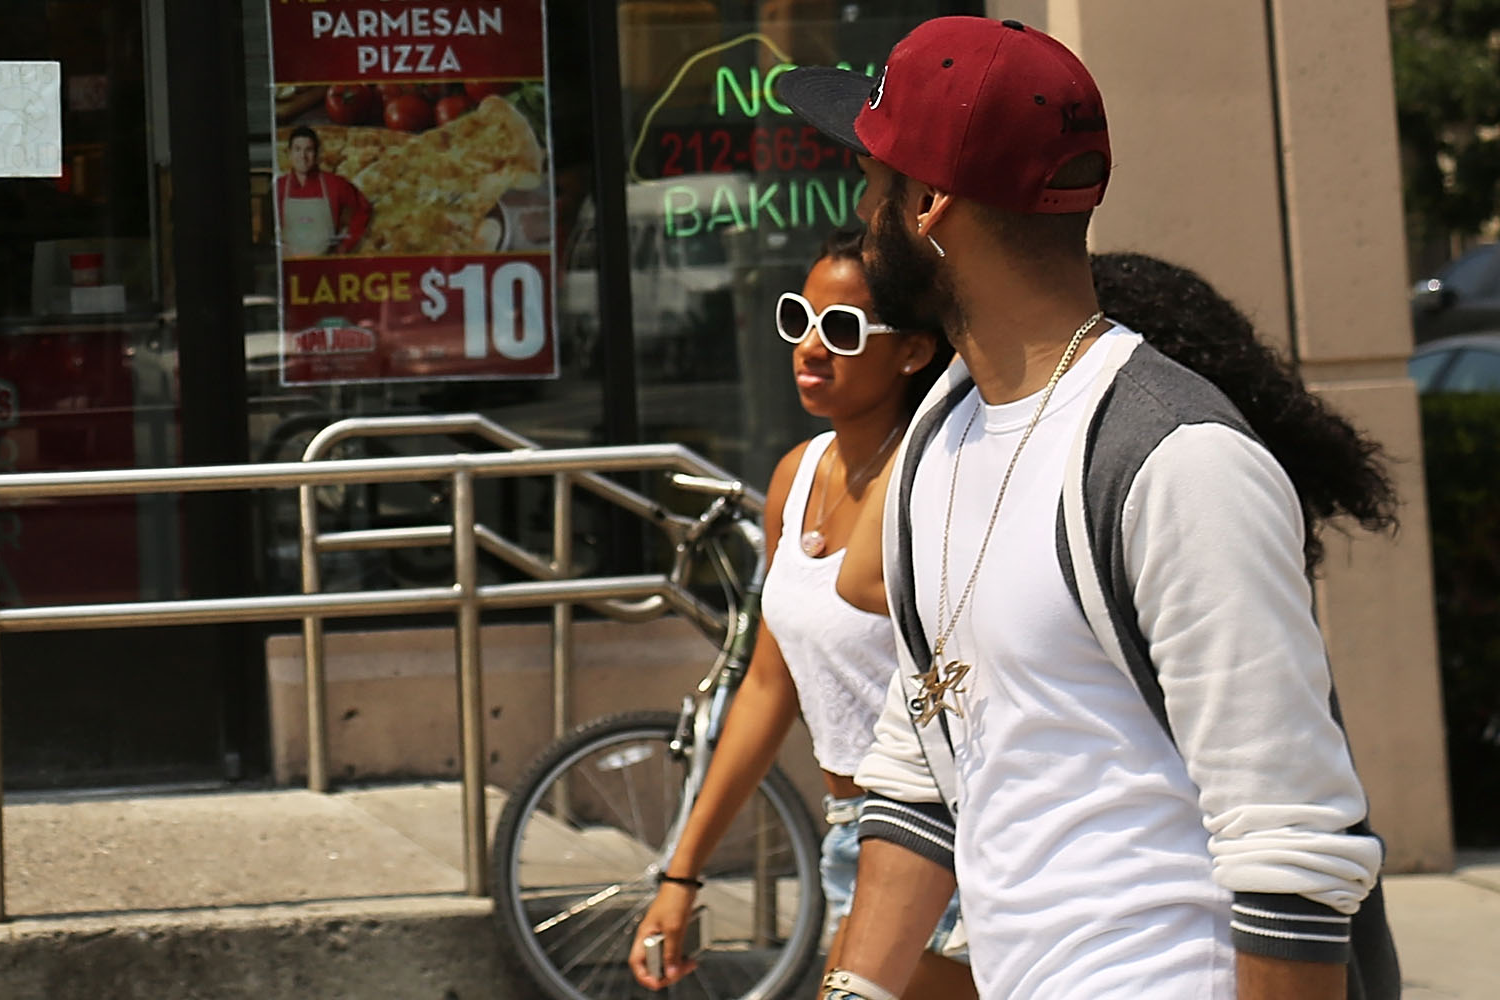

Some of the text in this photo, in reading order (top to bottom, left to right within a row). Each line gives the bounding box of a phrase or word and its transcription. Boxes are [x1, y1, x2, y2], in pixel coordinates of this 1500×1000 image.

[311, 7, 503, 39] PARMESAN
[357, 44, 461, 74] PIZZA
[663, 177, 867, 237] BAKIN
[289, 260, 547, 360] LARGE $10
